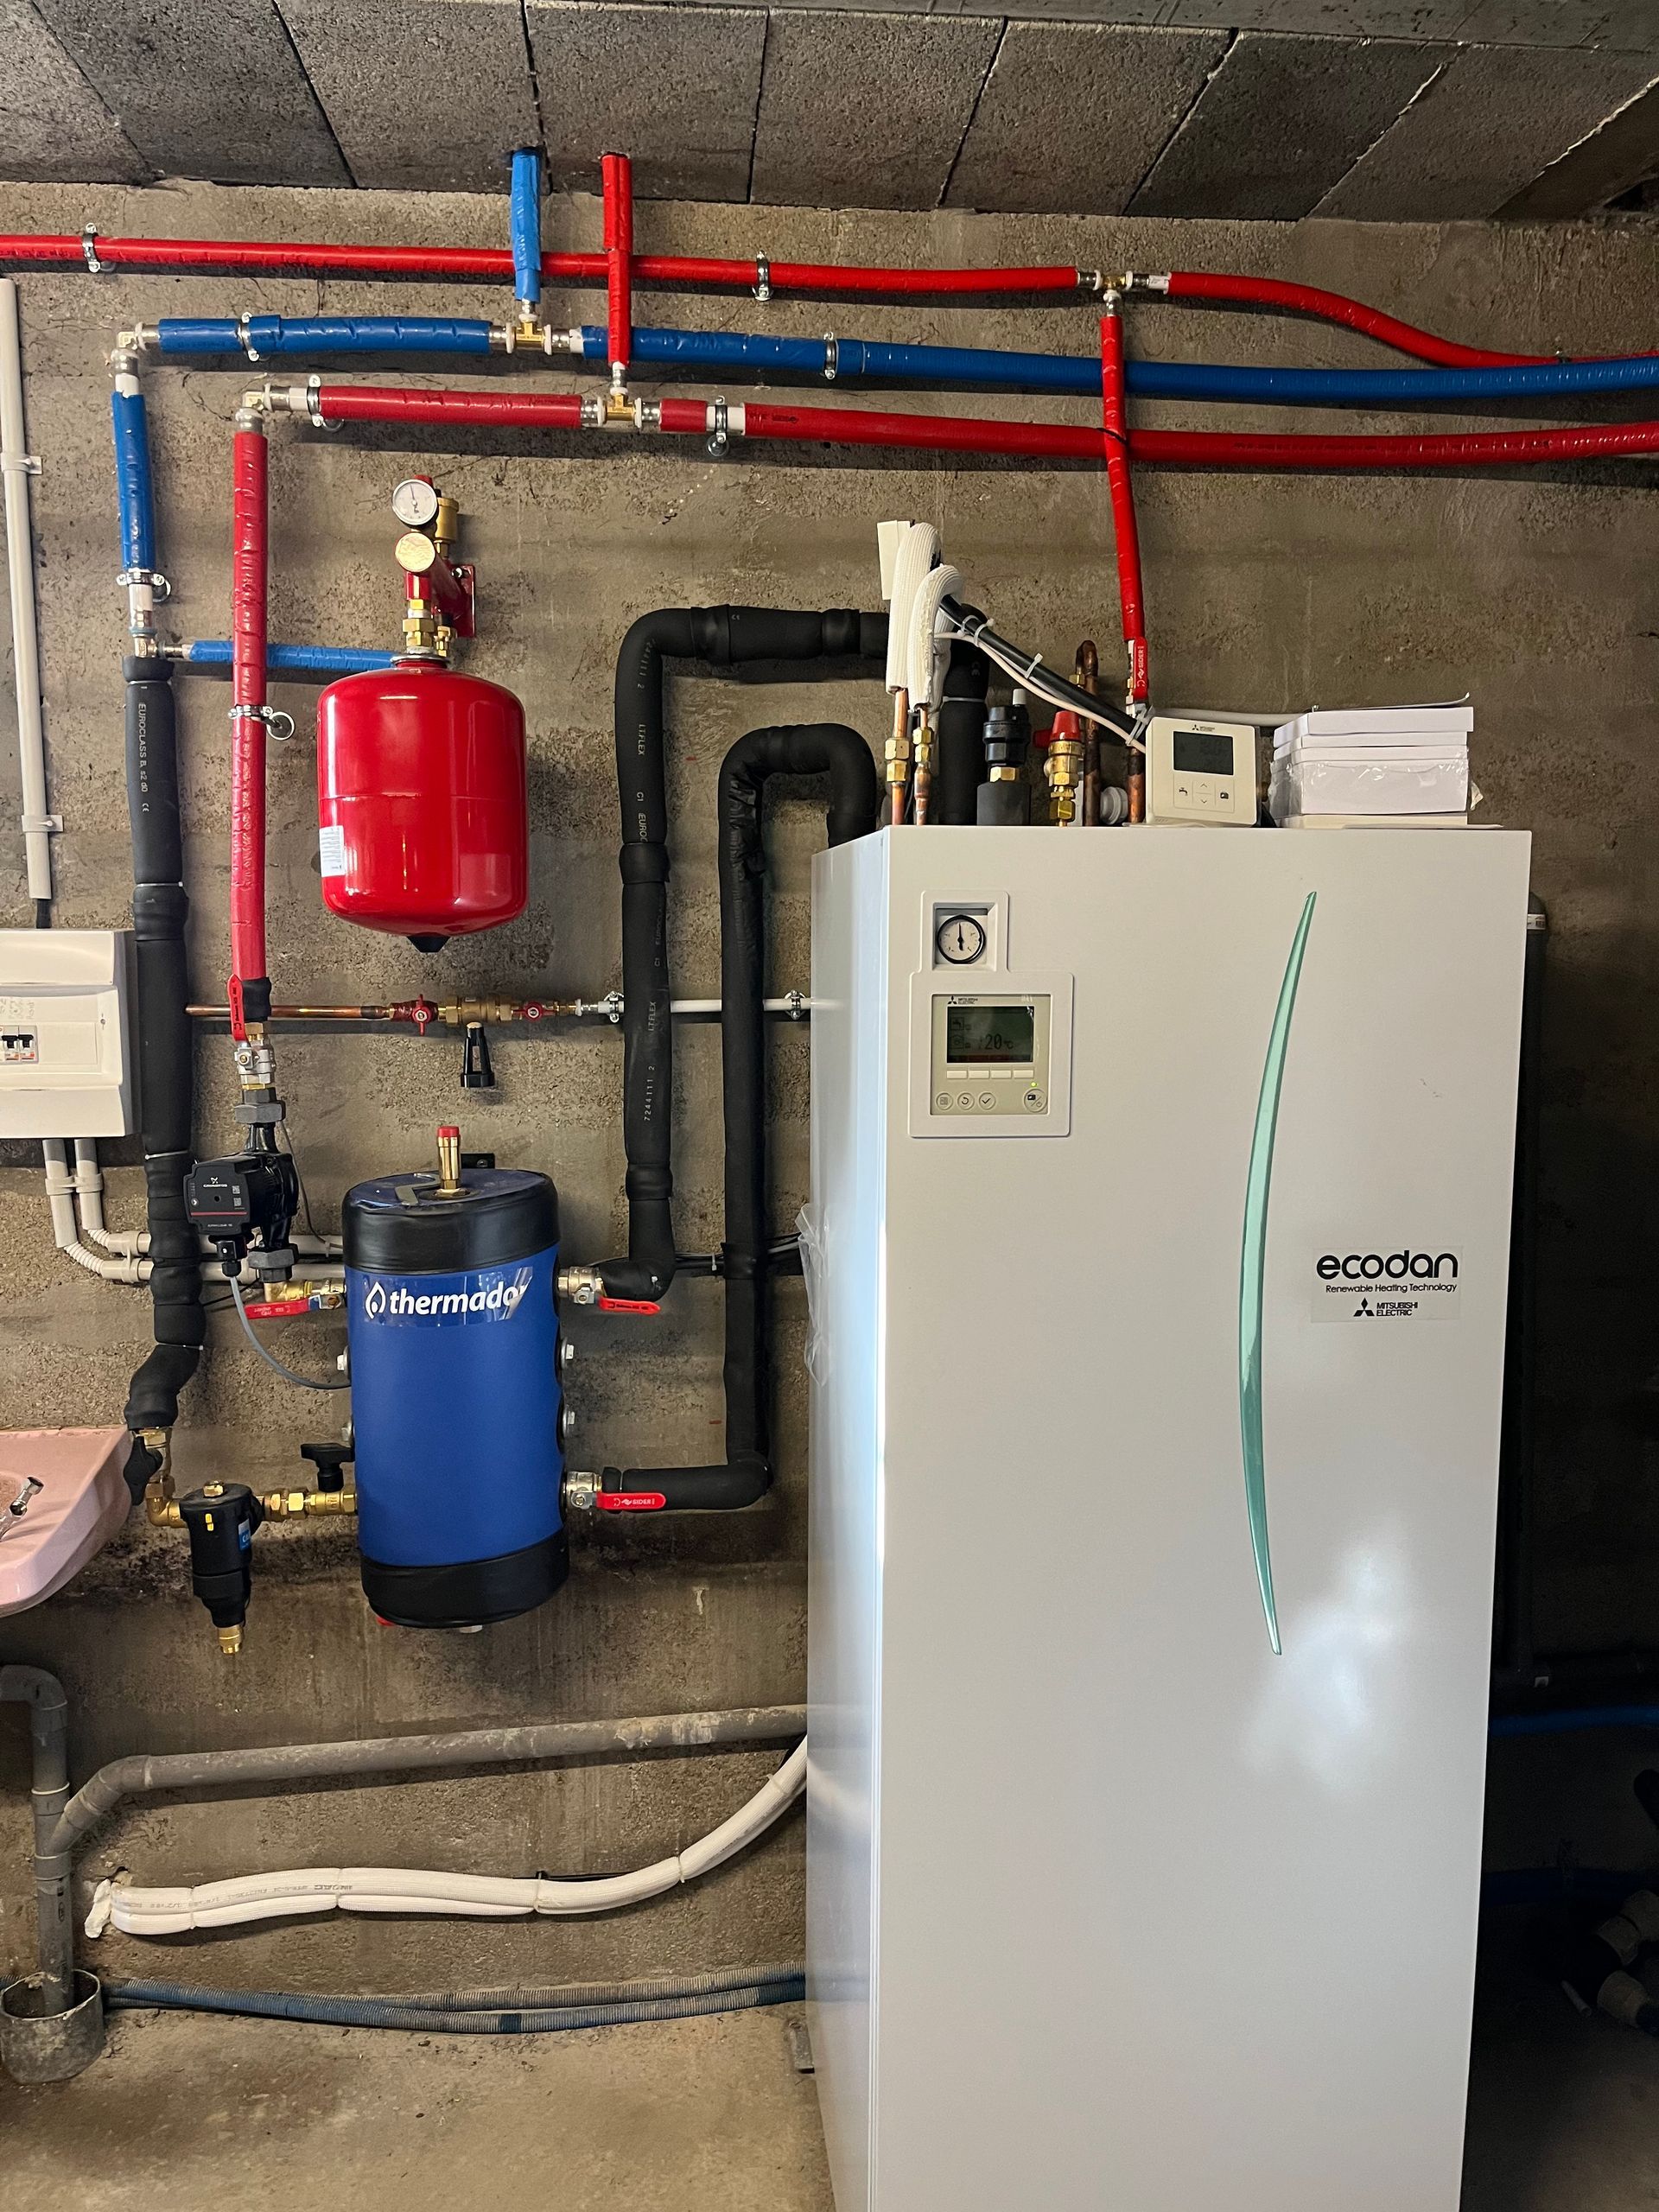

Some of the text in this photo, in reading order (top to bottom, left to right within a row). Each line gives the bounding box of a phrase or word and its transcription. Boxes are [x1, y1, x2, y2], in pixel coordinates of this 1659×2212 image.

[138, 702, 147, 758] EUROCLASS
[1316, 1249, 1459, 1281] ecodan
[1325, 1283, 1458, 1294] Renewable Heating Technology
[1376, 1301, 1418, 1310] MITSUBISHI
